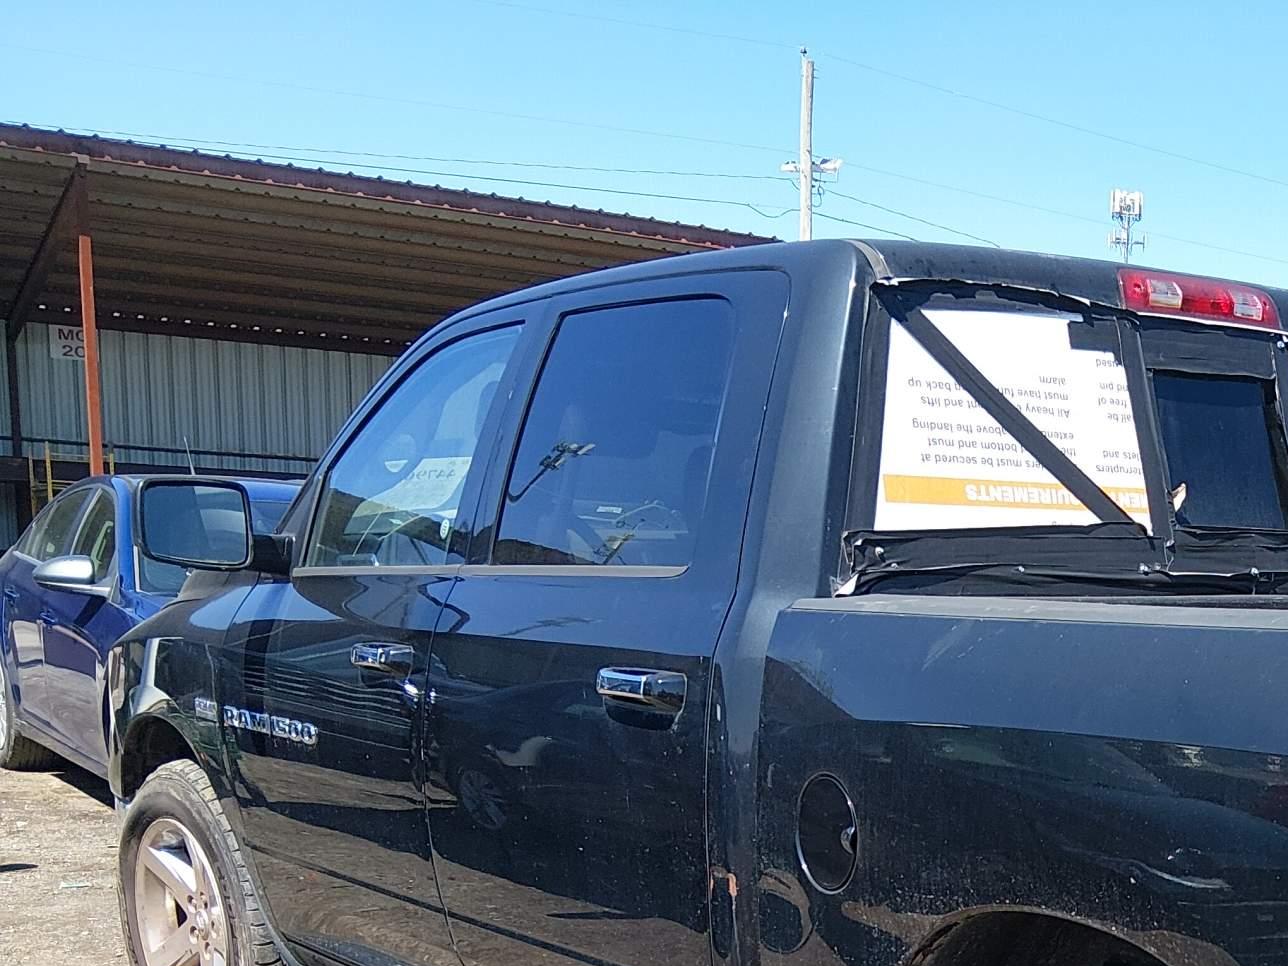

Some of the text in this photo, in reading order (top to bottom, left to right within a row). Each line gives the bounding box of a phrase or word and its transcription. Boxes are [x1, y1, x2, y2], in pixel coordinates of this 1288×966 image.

[907, 376, 922, 387] up
[926, 379, 952, 391] back
[1038, 375, 1066, 386] alarm
[1017, 388, 1042, 400] have
[1044, 391, 1069, 401] must
[920, 395, 941, 407] lifts
[943, 398, 964, 408] and
[1025, 402, 1055, 415] heavy
[1057, 407, 1070, 419] All
[911, 417, 954, 430] landing
[956, 421, 974, 432] the
[927, 437, 955, 448] must
[957, 439, 977, 449] and
[980, 440, 1018, 452] bottom
[920, 452, 932, 464] at
[934, 453, 978, 465] secured
[1101, 449, 1120, 459] and
[980, 457, 994, 468] be
[996, 457, 1022, 468] must
[223, 705, 271, 736] RAM
[270, 715, 319, 745] 1500
